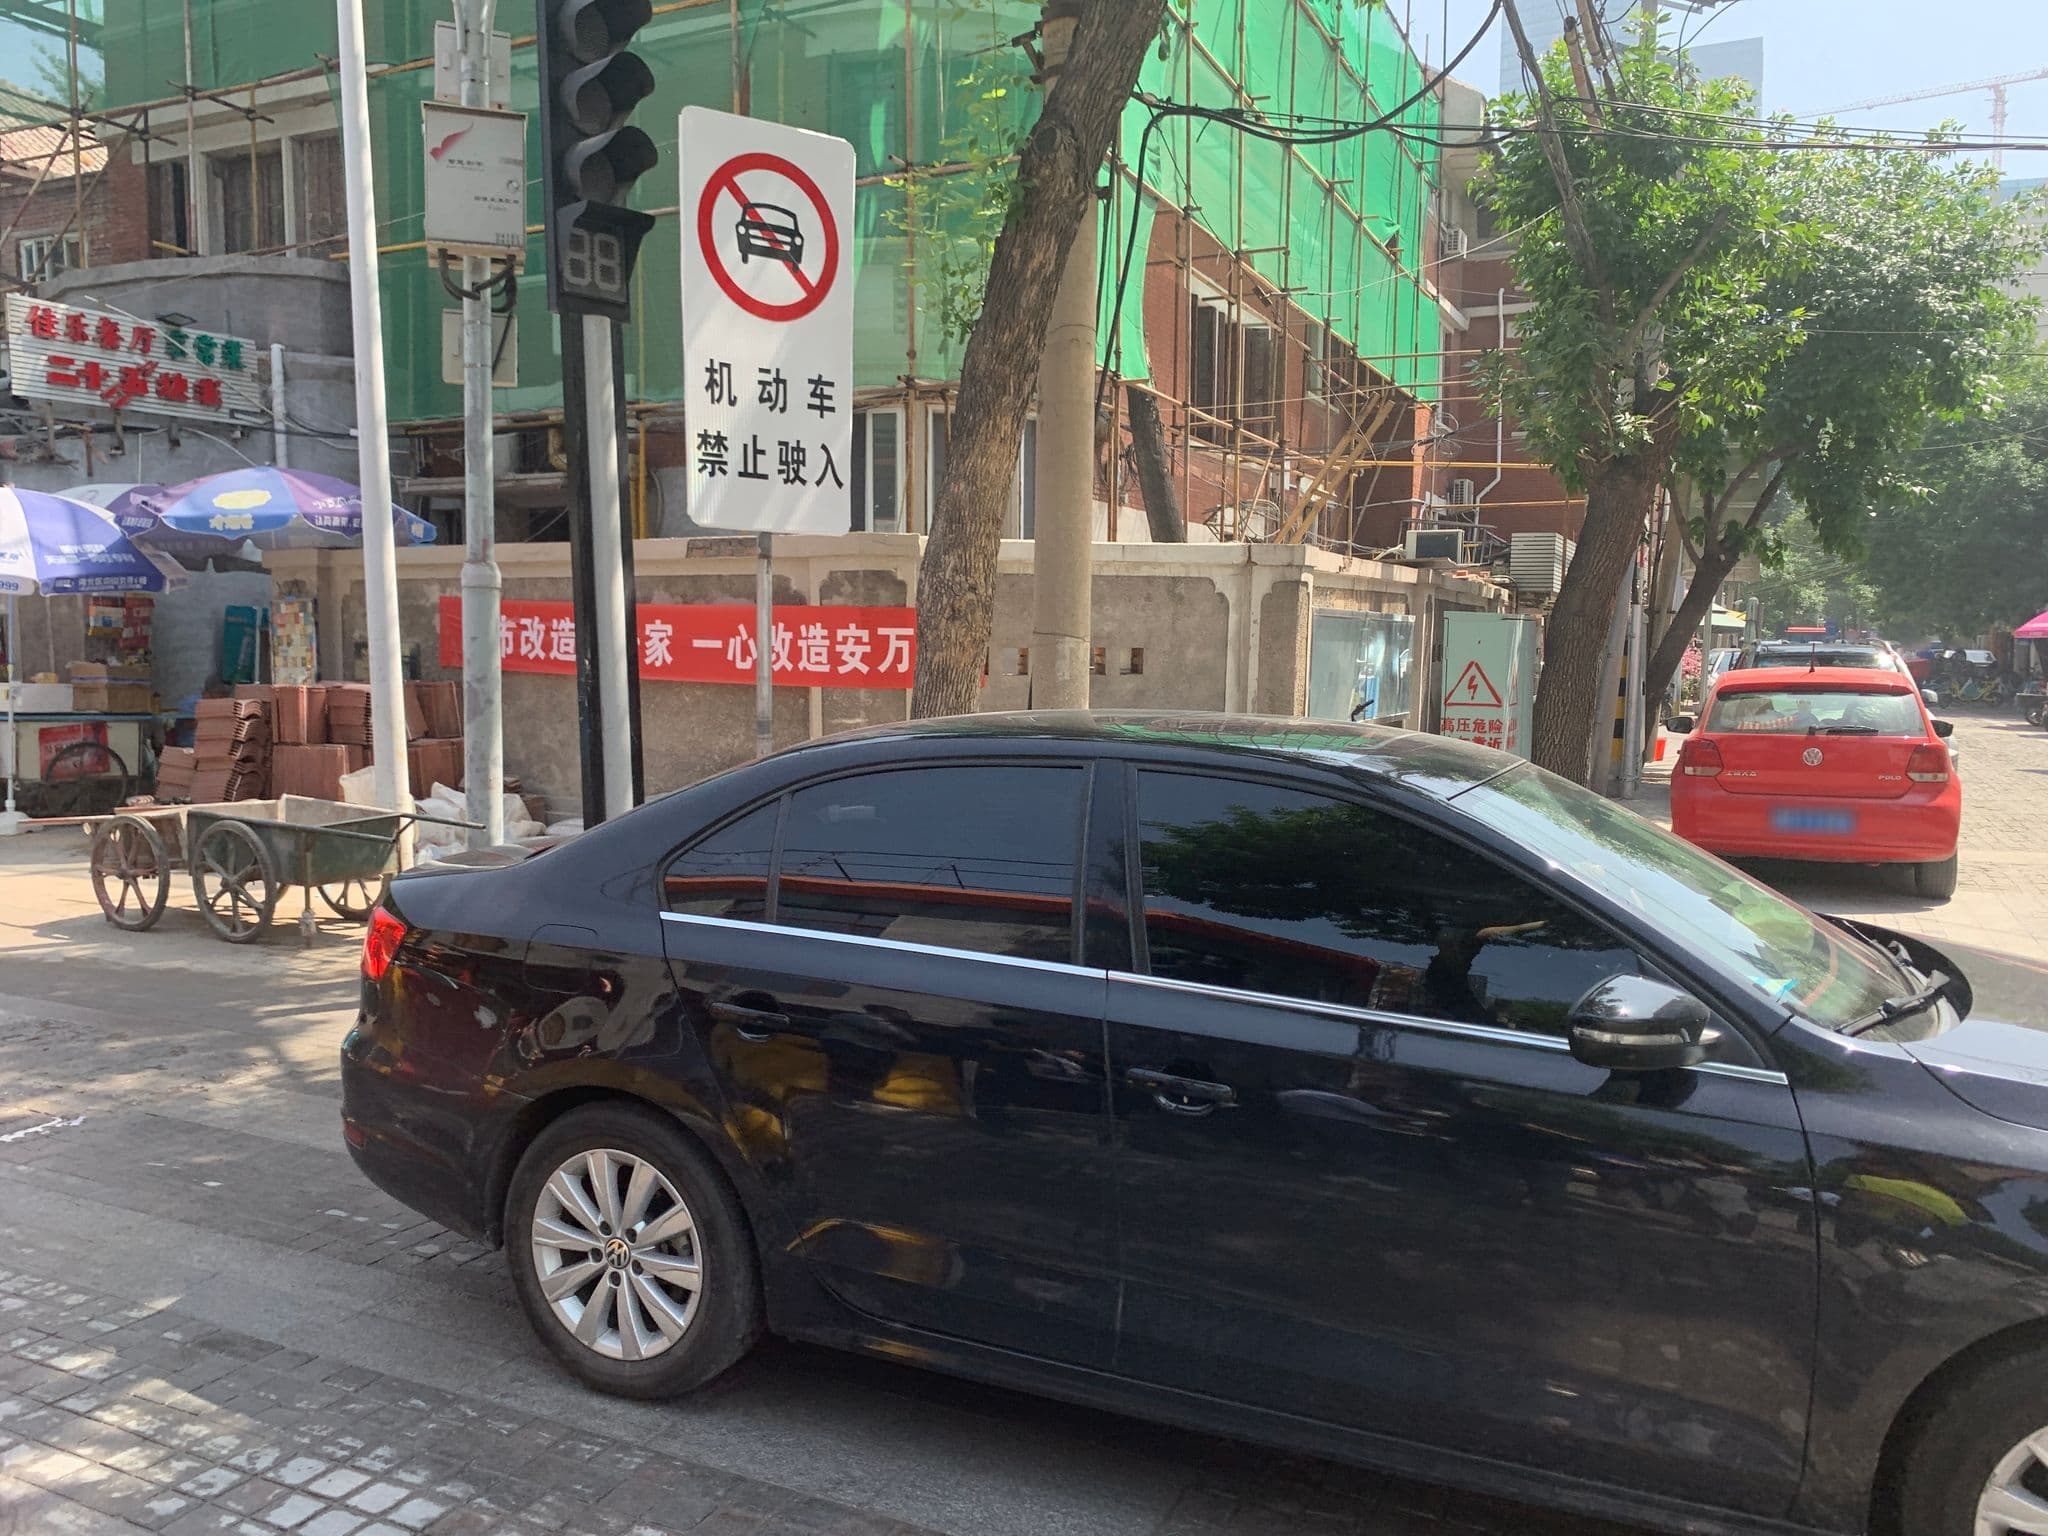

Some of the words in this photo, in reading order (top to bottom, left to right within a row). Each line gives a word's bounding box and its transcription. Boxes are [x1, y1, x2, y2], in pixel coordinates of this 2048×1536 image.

[705, 359, 836, 419] 机动车
[697, 429, 844, 490] 禁止驶入
[1440, 717, 1504, 734] 高压危险
